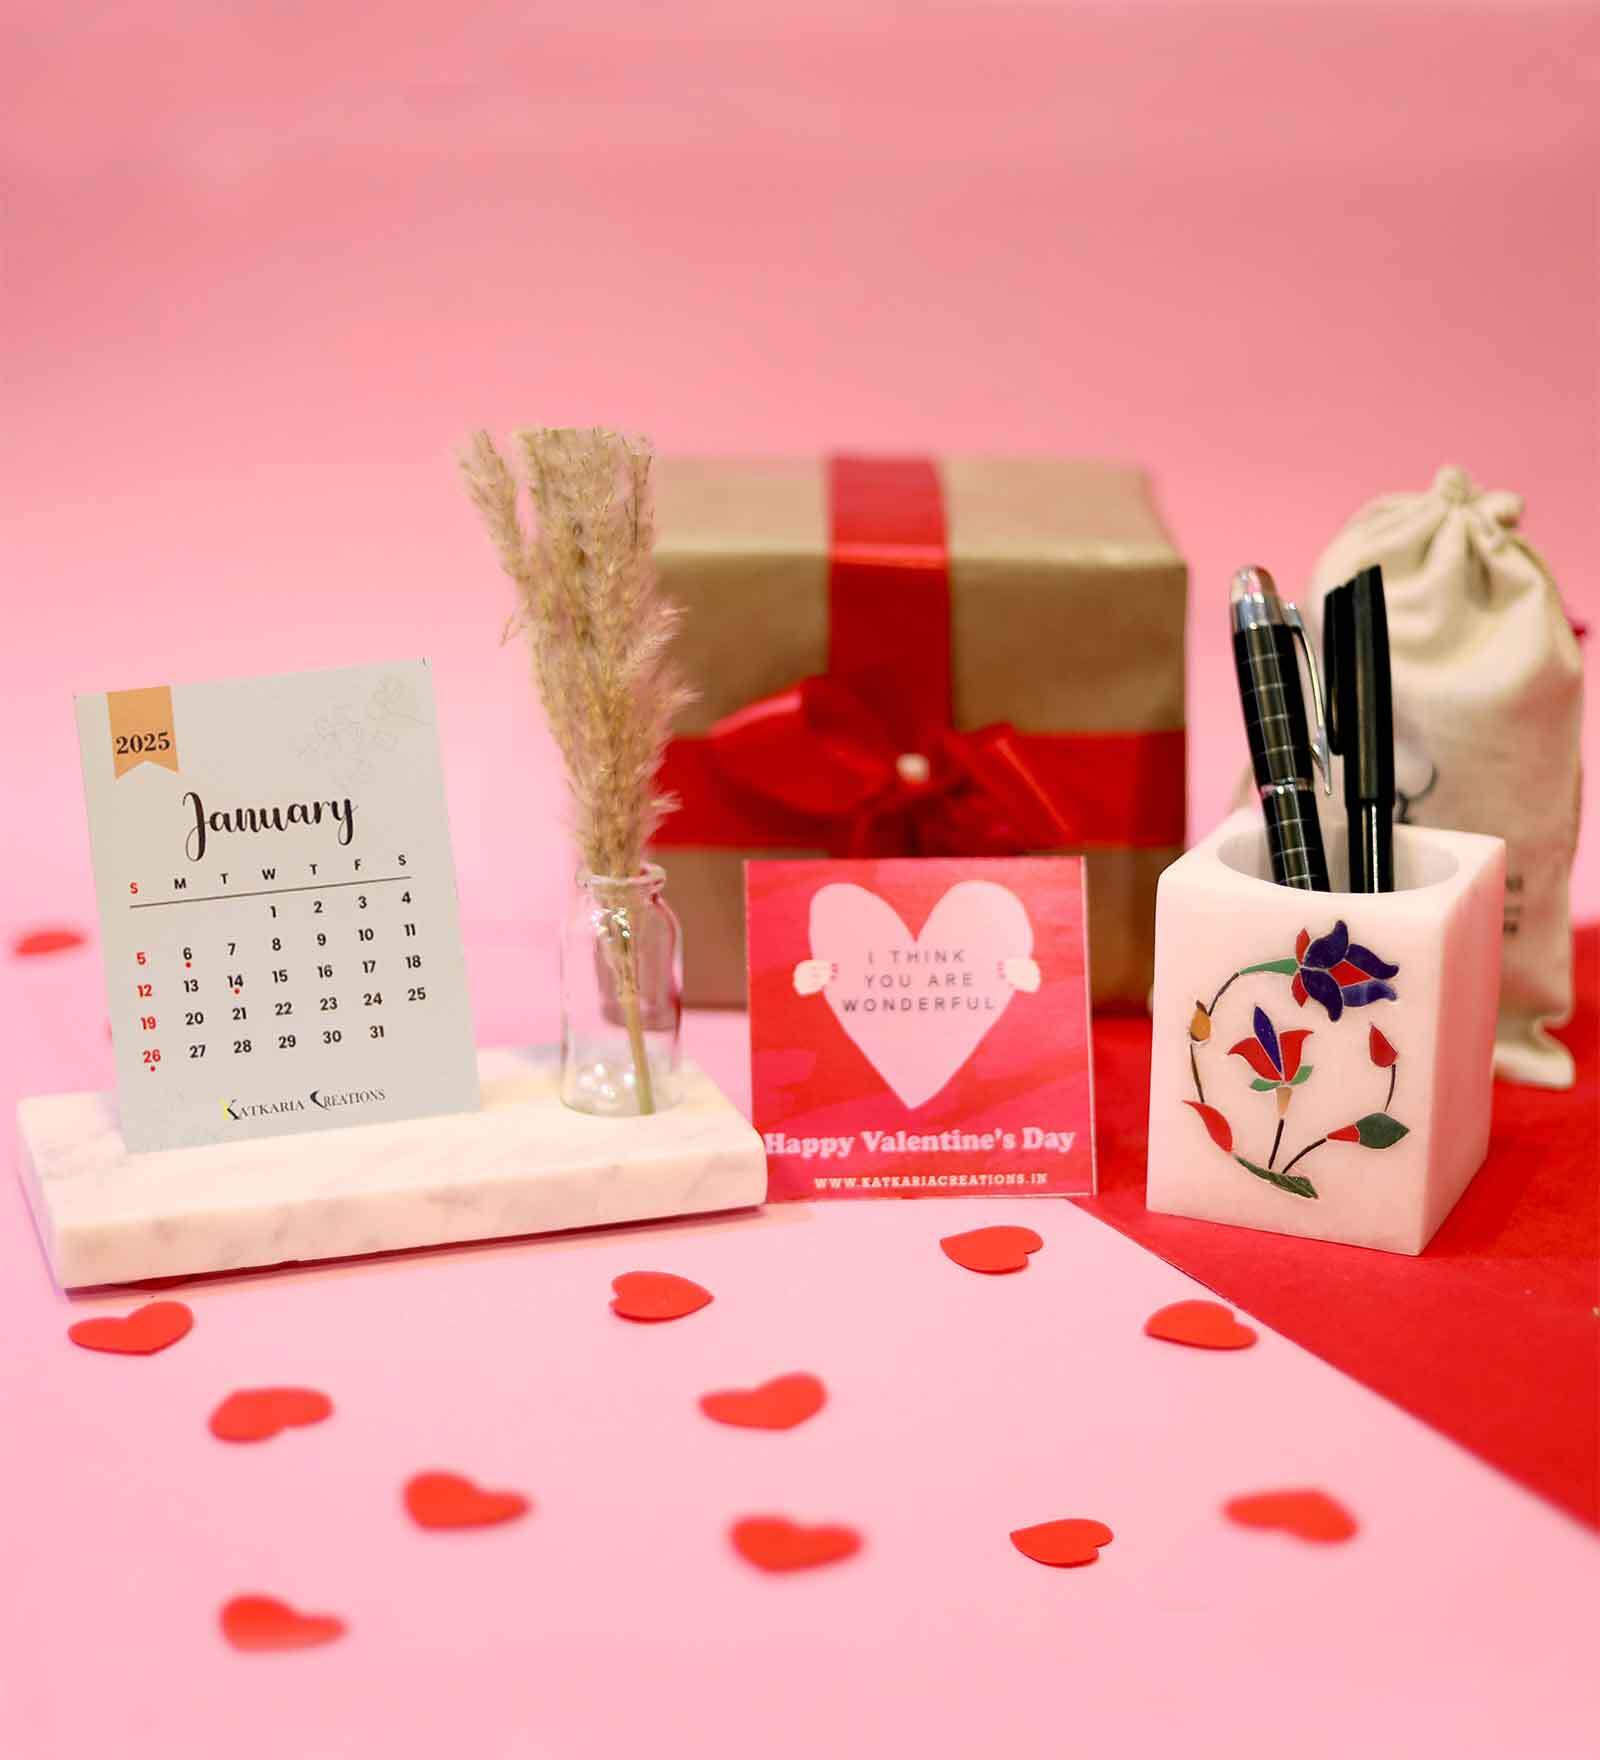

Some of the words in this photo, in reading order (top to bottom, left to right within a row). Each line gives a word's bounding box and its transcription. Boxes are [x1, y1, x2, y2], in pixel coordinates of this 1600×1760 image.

[115, 731, 171, 755] 2025
[182, 791, 359, 862] January
[129, 881, 139, 895] S
[173, 877, 187, 891] M
[219, 872, 229, 885] T
[261, 867, 276, 881] W
[309, 863, 318, 876] T
[353, 858, 361, 871] F
[397, 853, 407, 867] S
[269, 905, 277, 919] 1
[313, 900, 324, 914] 2
[357, 895, 368, 910] 3
[400, 890, 412, 905] 4
[136, 951, 147, 966] 5
[182, 946, 193, 961] 6
[227, 942, 236, 957] 7
[271, 937, 282, 952] 8
[316, 932, 327, 947] 9
[357, 927, 375, 942] 10
[403, 922, 417, 937] 11
[867, 950, 874, 964] I
[890, 949, 966, 964] THINK
[136, 983, 153, 999] 12
[183, 978, 200, 993] 13
[226, 973, 245, 989] 14
[271, 968, 289, 984] 15
[316, 963, 334, 979] 16
[361, 959, 377, 974] 17
[405, 954, 422, 969] 18
[865, 973, 912, 988] YOU
[928, 972, 974, 987] ARE
[140, 1015, 157, 1031] 19
[184, 1011, 205, 1026] 20
[231, 1006, 247, 1021] 21
[274, 1001, 293, 1017] 22
[319, 996, 338, 1012] 23
[362, 991, 384, 1007] 24
[407, 986, 427, 1002] 25
[843, 996, 995, 1012] WONDERFUL
[142, 1048, 162, 1064] 26
[189, 1044, 207, 1059] 27
[233, 1039, 253, 1055] 28
[277, 1034, 297, 1049] 29
[322, 1029, 343, 1045] 30
[369, 1024, 385, 1040] 31
[226, 1099, 305, 1120] KATKARIA
[310, 1089, 386, 1111] CREATIONS
[764, 1132, 854, 1159] Happy
[861, 1128, 1016, 1153] Valentine's
[1022, 1126, 1076, 1153] Day
[814, 1172, 1048, 1190] WWW.KATKARIACREATIONS.IN
